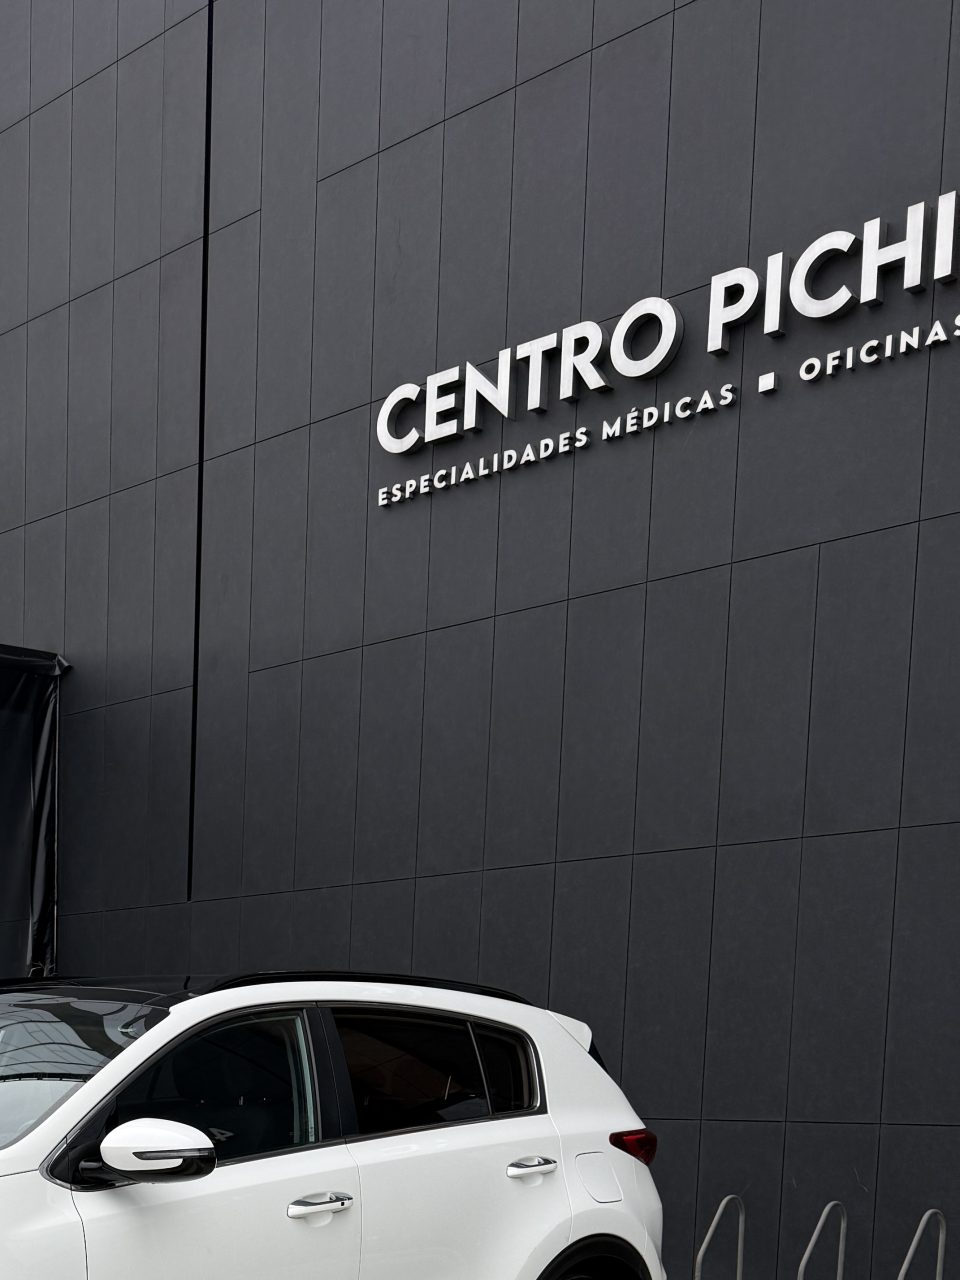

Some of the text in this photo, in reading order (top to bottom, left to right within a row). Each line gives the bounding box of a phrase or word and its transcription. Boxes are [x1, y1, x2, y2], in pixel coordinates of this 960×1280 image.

[377, 190, 957, 454] CENTRO PICHI
[378, 427, 589, 507] ESPECIALIDADES
[602, 384, 734, 440] MÉDICAS
